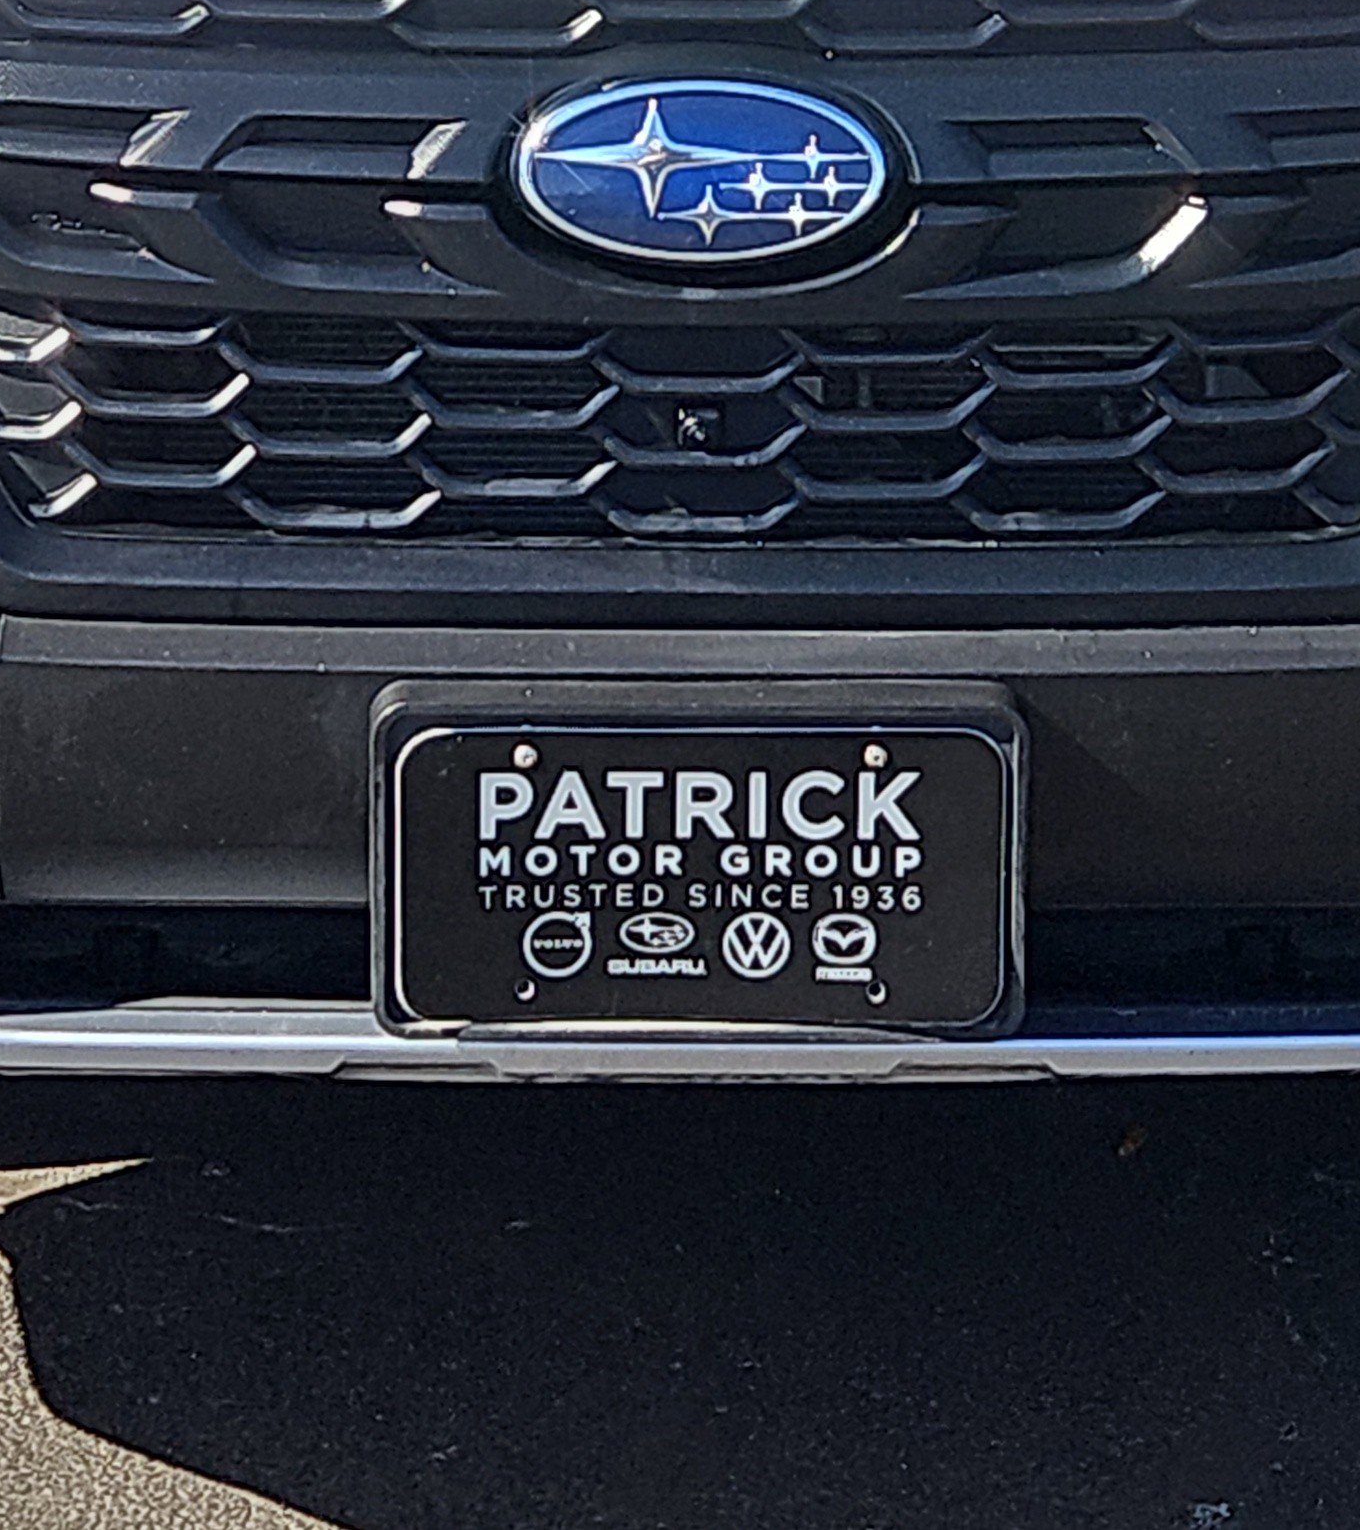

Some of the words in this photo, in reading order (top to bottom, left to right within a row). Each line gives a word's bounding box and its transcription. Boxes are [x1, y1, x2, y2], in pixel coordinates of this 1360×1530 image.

[479, 770, 921, 841] PATRICK
[479, 844, 683, 877] MOTOR
[719, 844, 922, 878] GROUP
[478, 883, 665, 910] TRUSTED
[688, 883, 810, 910] SINCE
[832, 883, 922, 911] 1936
[606, 957, 708, 977] SUBARU
